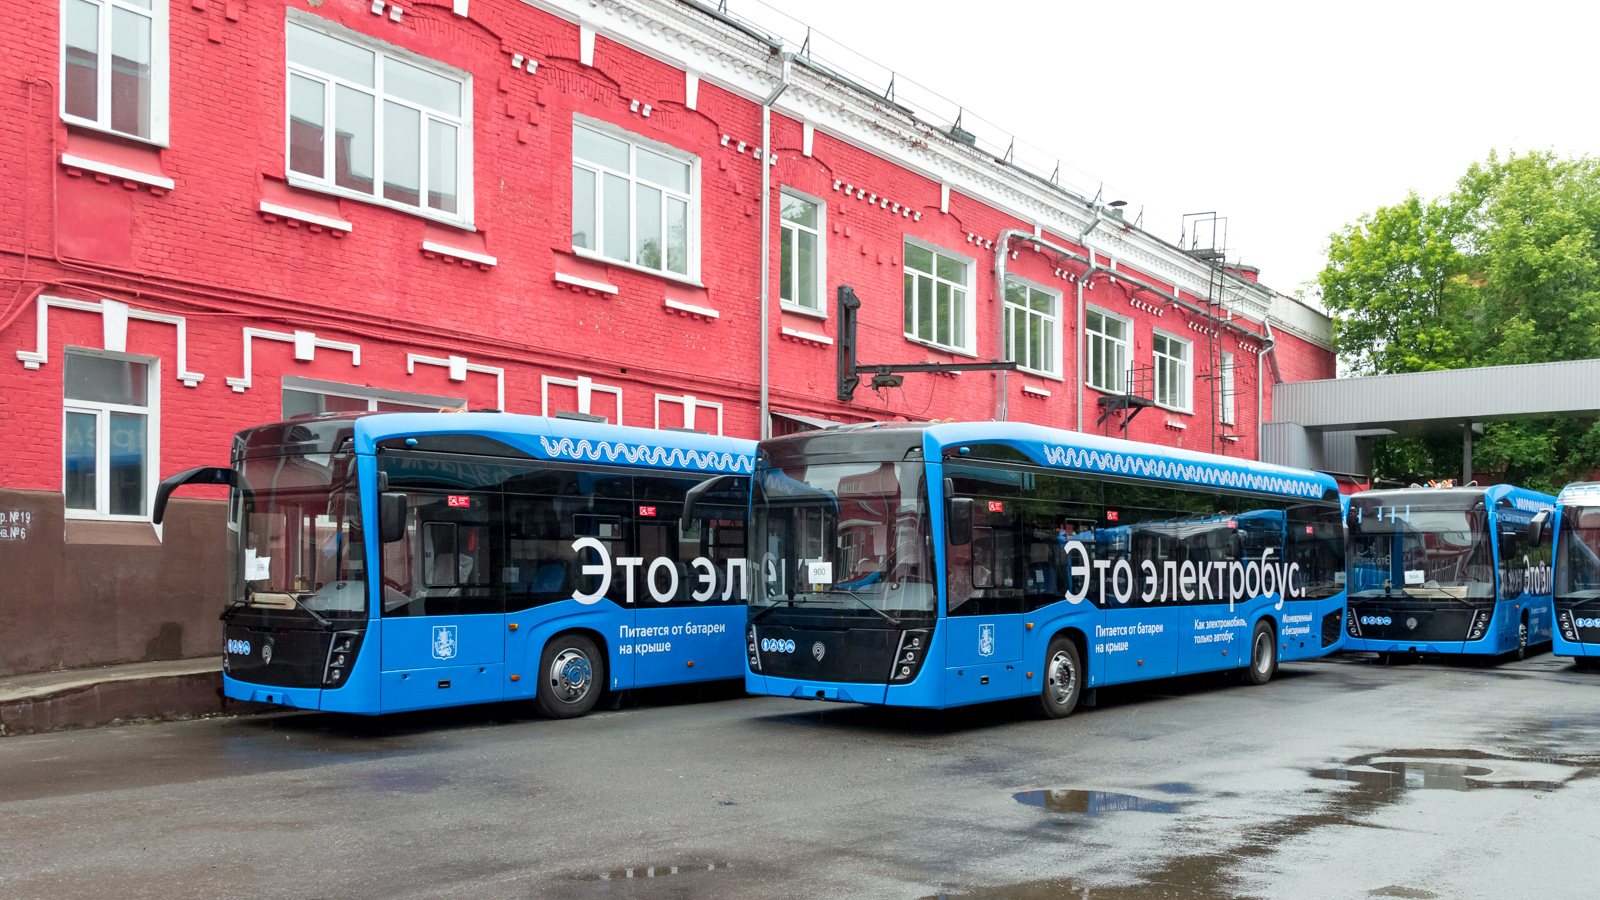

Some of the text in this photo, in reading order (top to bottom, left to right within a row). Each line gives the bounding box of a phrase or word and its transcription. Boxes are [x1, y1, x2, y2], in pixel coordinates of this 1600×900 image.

[571, 537, 679, 605] Это
[813, 567, 826, 576] 900
[1064, 541, 1306, 612] Это электробус.
[619, 621, 726, 639] Питается от батареи
[1095, 621, 1164, 638] Питается от батареи
[1194, 615, 1248, 631] Как электромобиль,
[1193, 629, 1234, 644] только автобус
[619, 641, 672, 656] на крыше
[1095, 641, 1129, 655] на крыше
